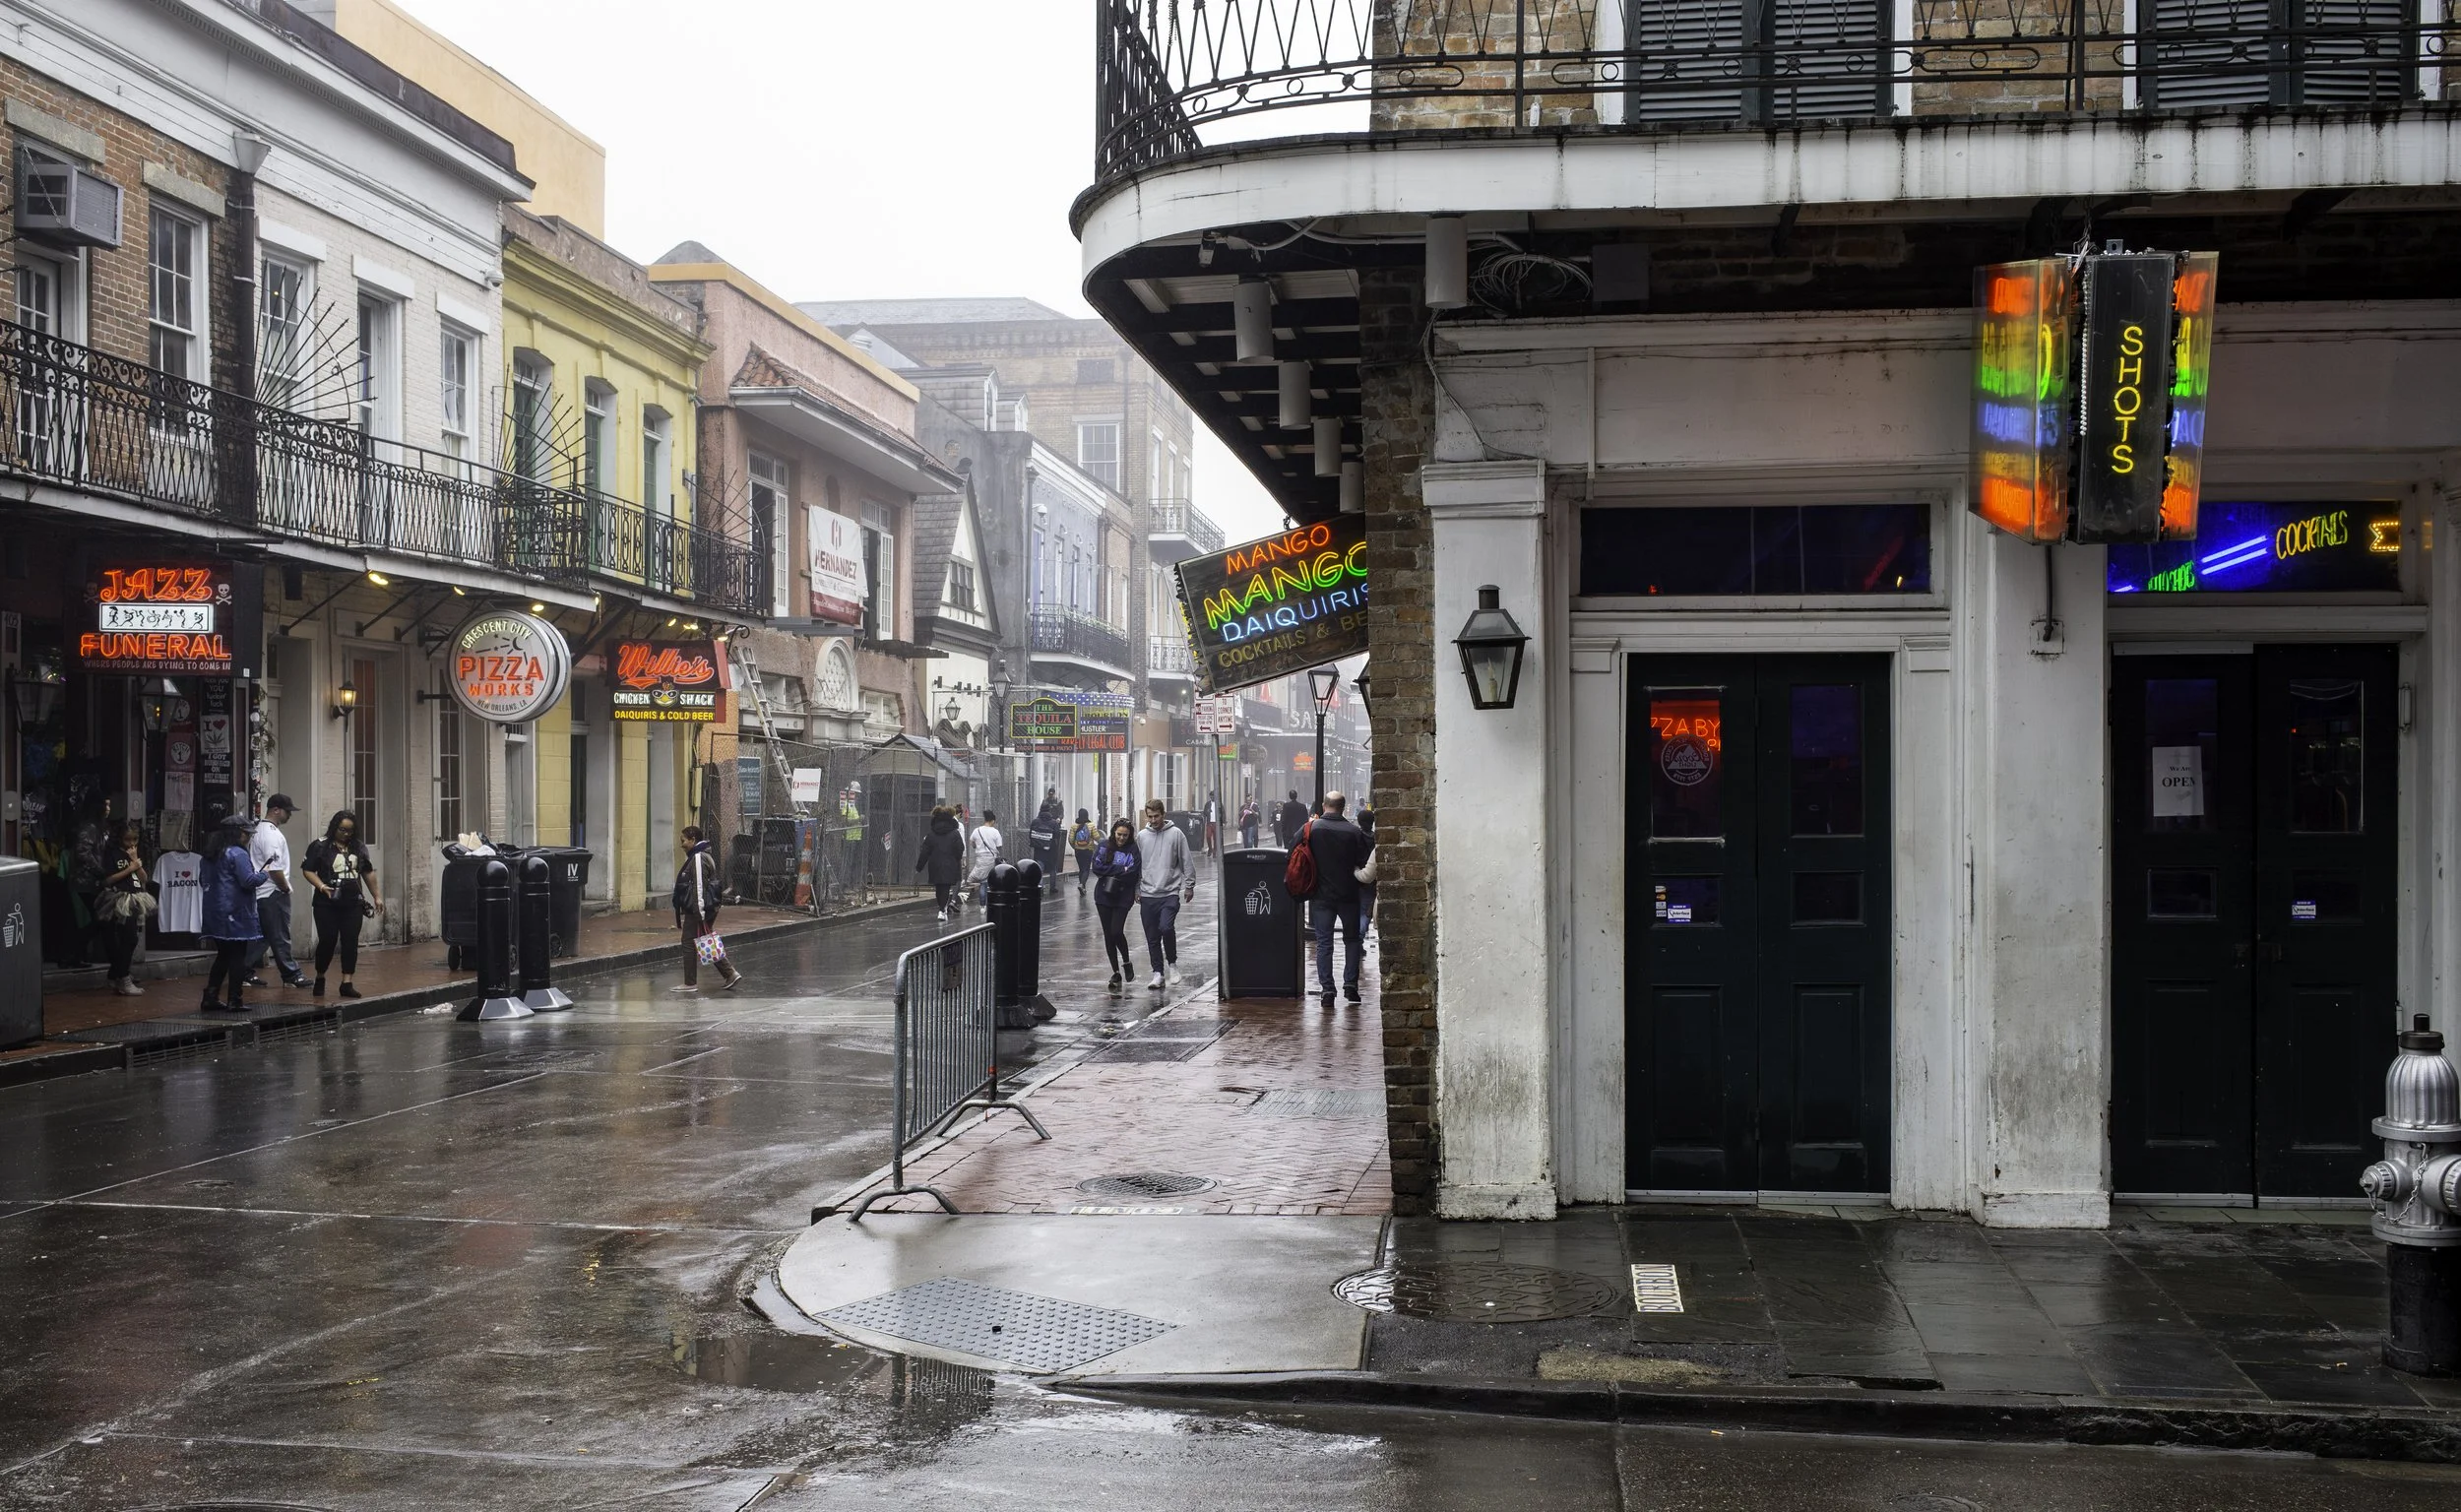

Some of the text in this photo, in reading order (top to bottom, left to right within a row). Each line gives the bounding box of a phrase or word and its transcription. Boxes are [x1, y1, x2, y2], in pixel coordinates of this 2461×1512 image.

[2112, 326, 2143, 473] SHOTS
[2275, 510, 2348, 560] COCKTAILS
[1227, 525, 1329, 575] MANGO
[814, 547, 857, 581] HERNANDEZ
[99, 567, 213, 602] JAZZ
[1203, 541, 1368, 630] MANGO
[462, 619, 534, 650] CRESCENT CITY
[1219, 629, 1306, 667] COCKTAILS
[1317, 622, 1330, 639] &
[1340, 611, 1368, 631] BE
[81, 632, 232, 661] FUNERAL
[85, 660, 231, 670] WHERE PEOPLE ARE DYING TO COME IN
[459, 656, 544, 681] PIZZA
[617, 642, 711, 679] Willie's
[468, 682, 535, 697] WORKS
[614, 692, 715, 706] CHICKEN SHACK
[476, 699, 528, 713] NEW ORLEANS, LA
[614, 710, 714, 721] DAIQUIRIS & COLD BEER
[1016, 713, 1072, 724] TEQUILA
[1695, 718, 1721, 737] BY
[1027, 725, 1062, 735] HOUSE
[1088, 735, 1107, 749] LEGAL
[1108, 734, 1125, 749] CLUB
[2161, 777, 2196, 788] OPEN
[117, 859, 129, 869] SA
[567, 863, 579, 876] IV
[166, 879, 198, 888] BACON
[1634, 1265, 1681, 1312] BOURBON
